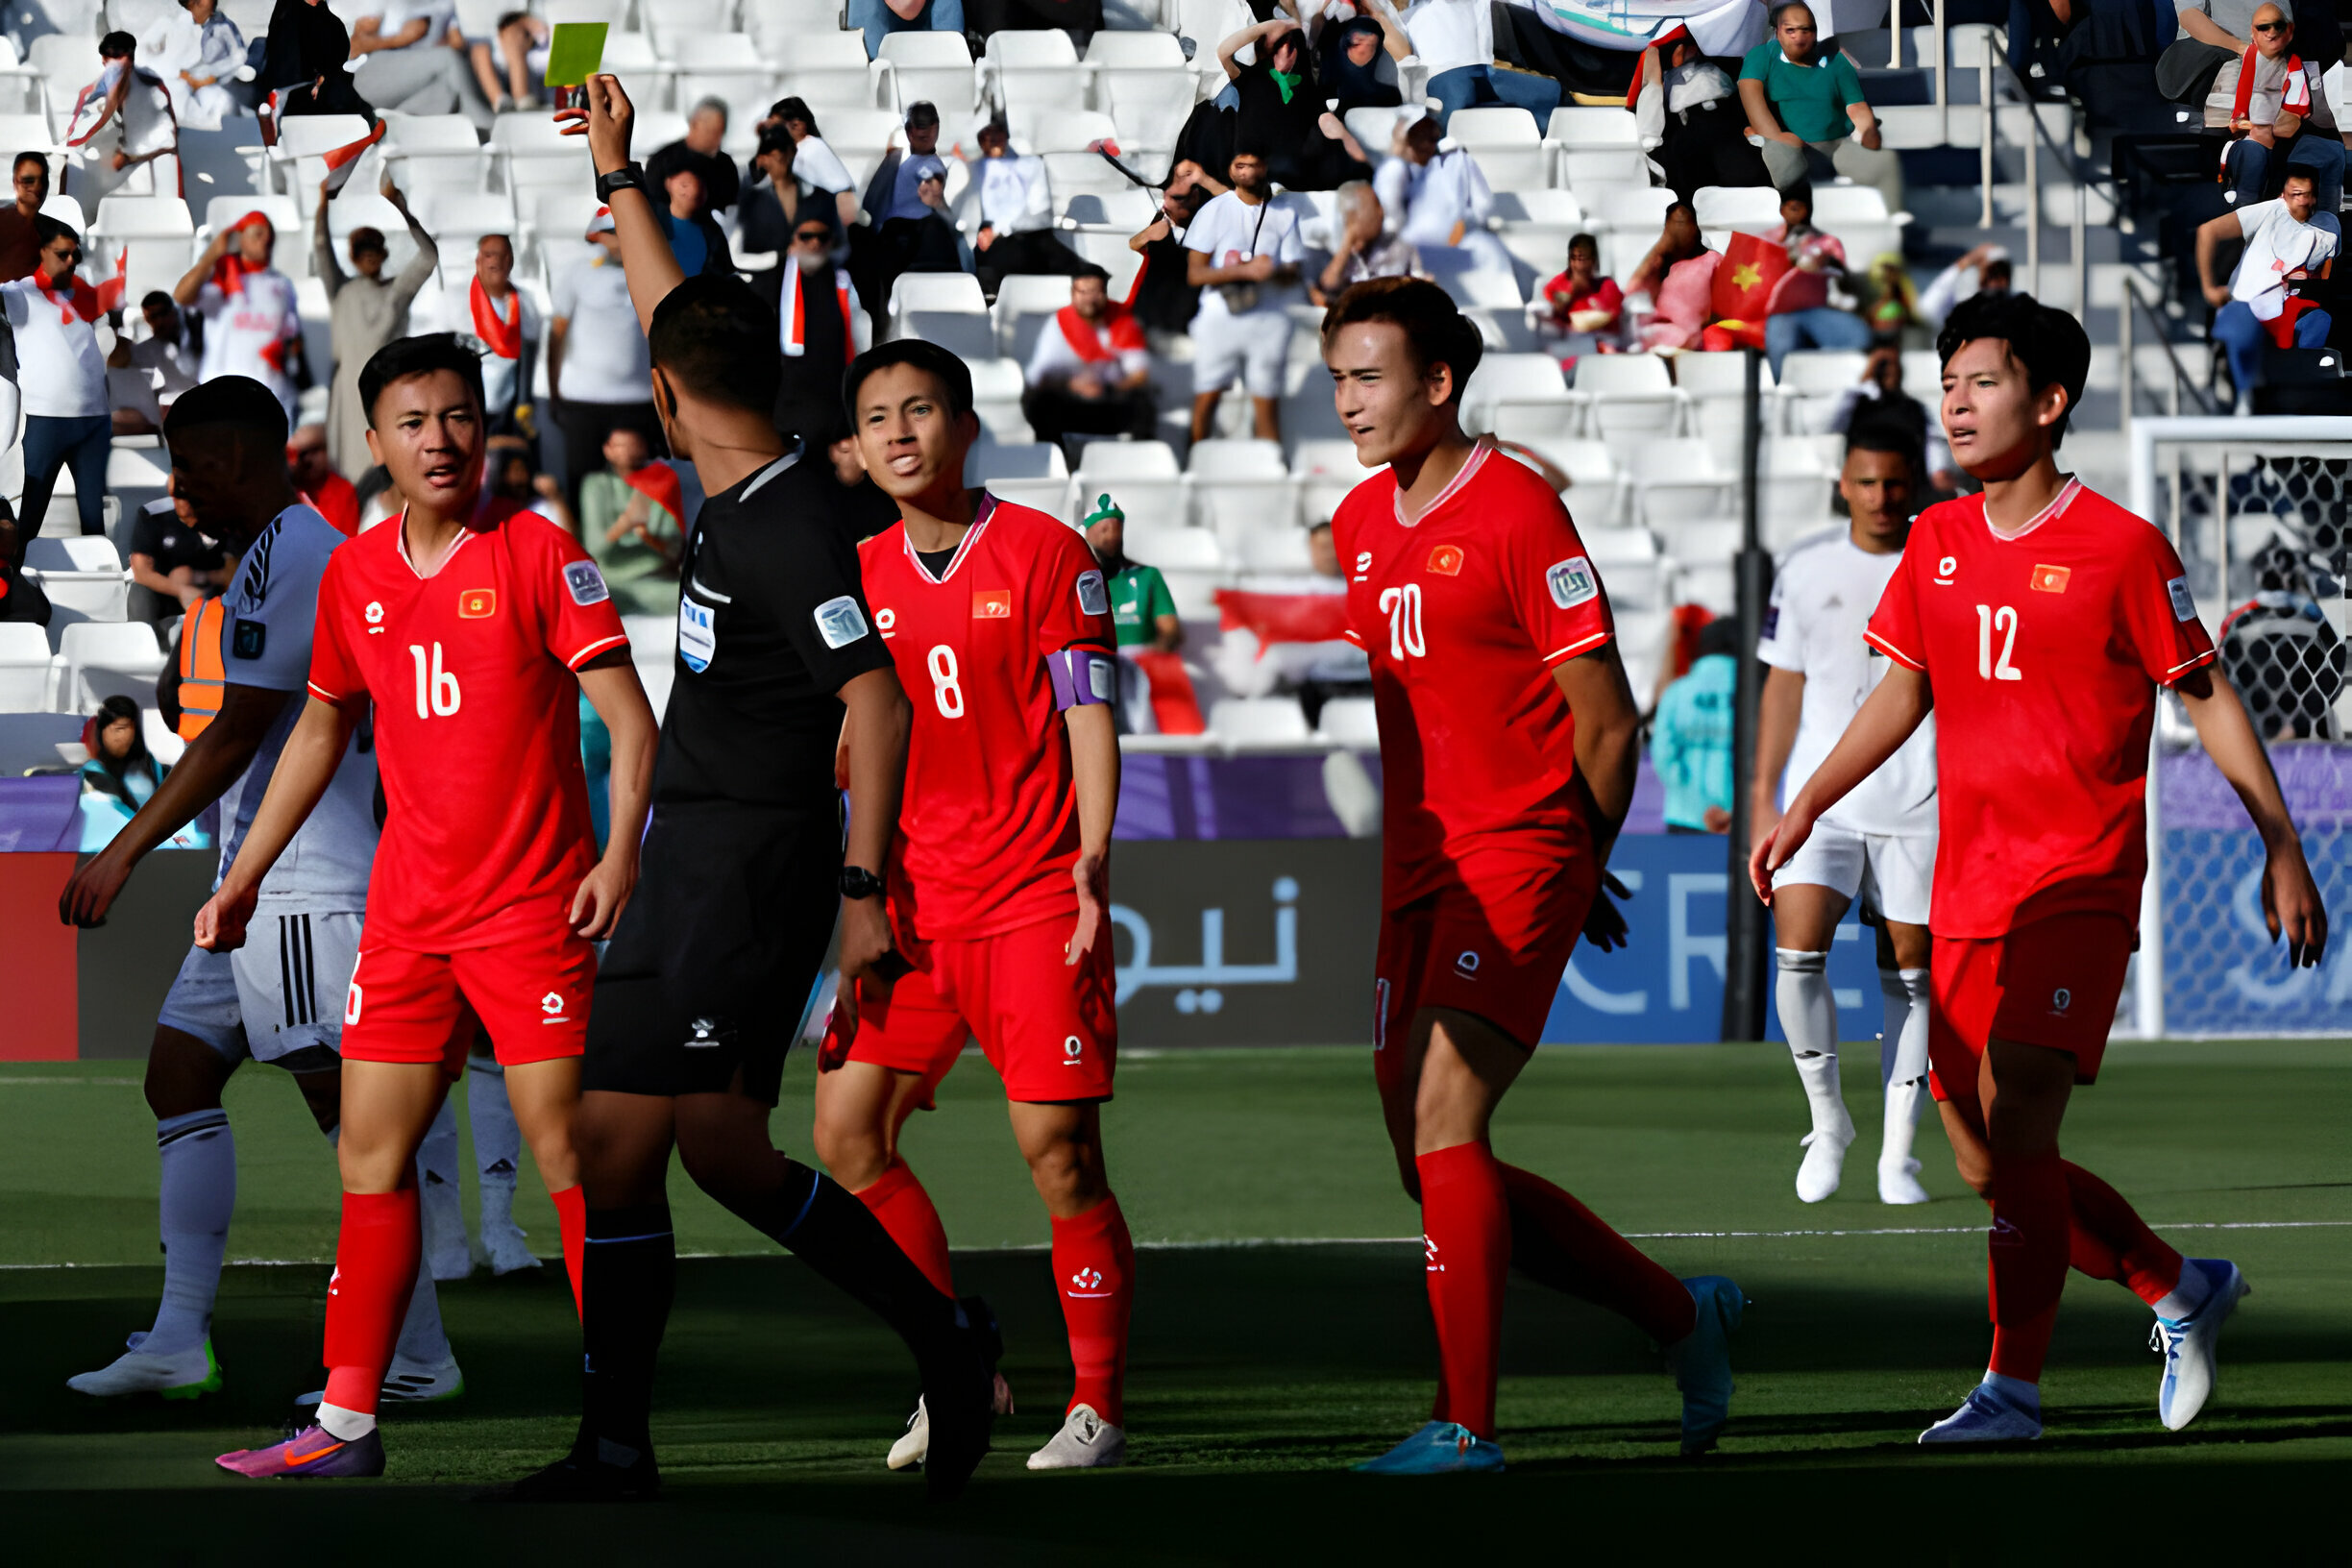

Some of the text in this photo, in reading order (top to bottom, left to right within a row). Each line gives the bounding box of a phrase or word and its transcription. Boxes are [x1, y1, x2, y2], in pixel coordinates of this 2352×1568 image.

[1975, 604, 2022, 680] 12
[409, 641, 461, 720] 16
[927, 644, 965, 719] 8
